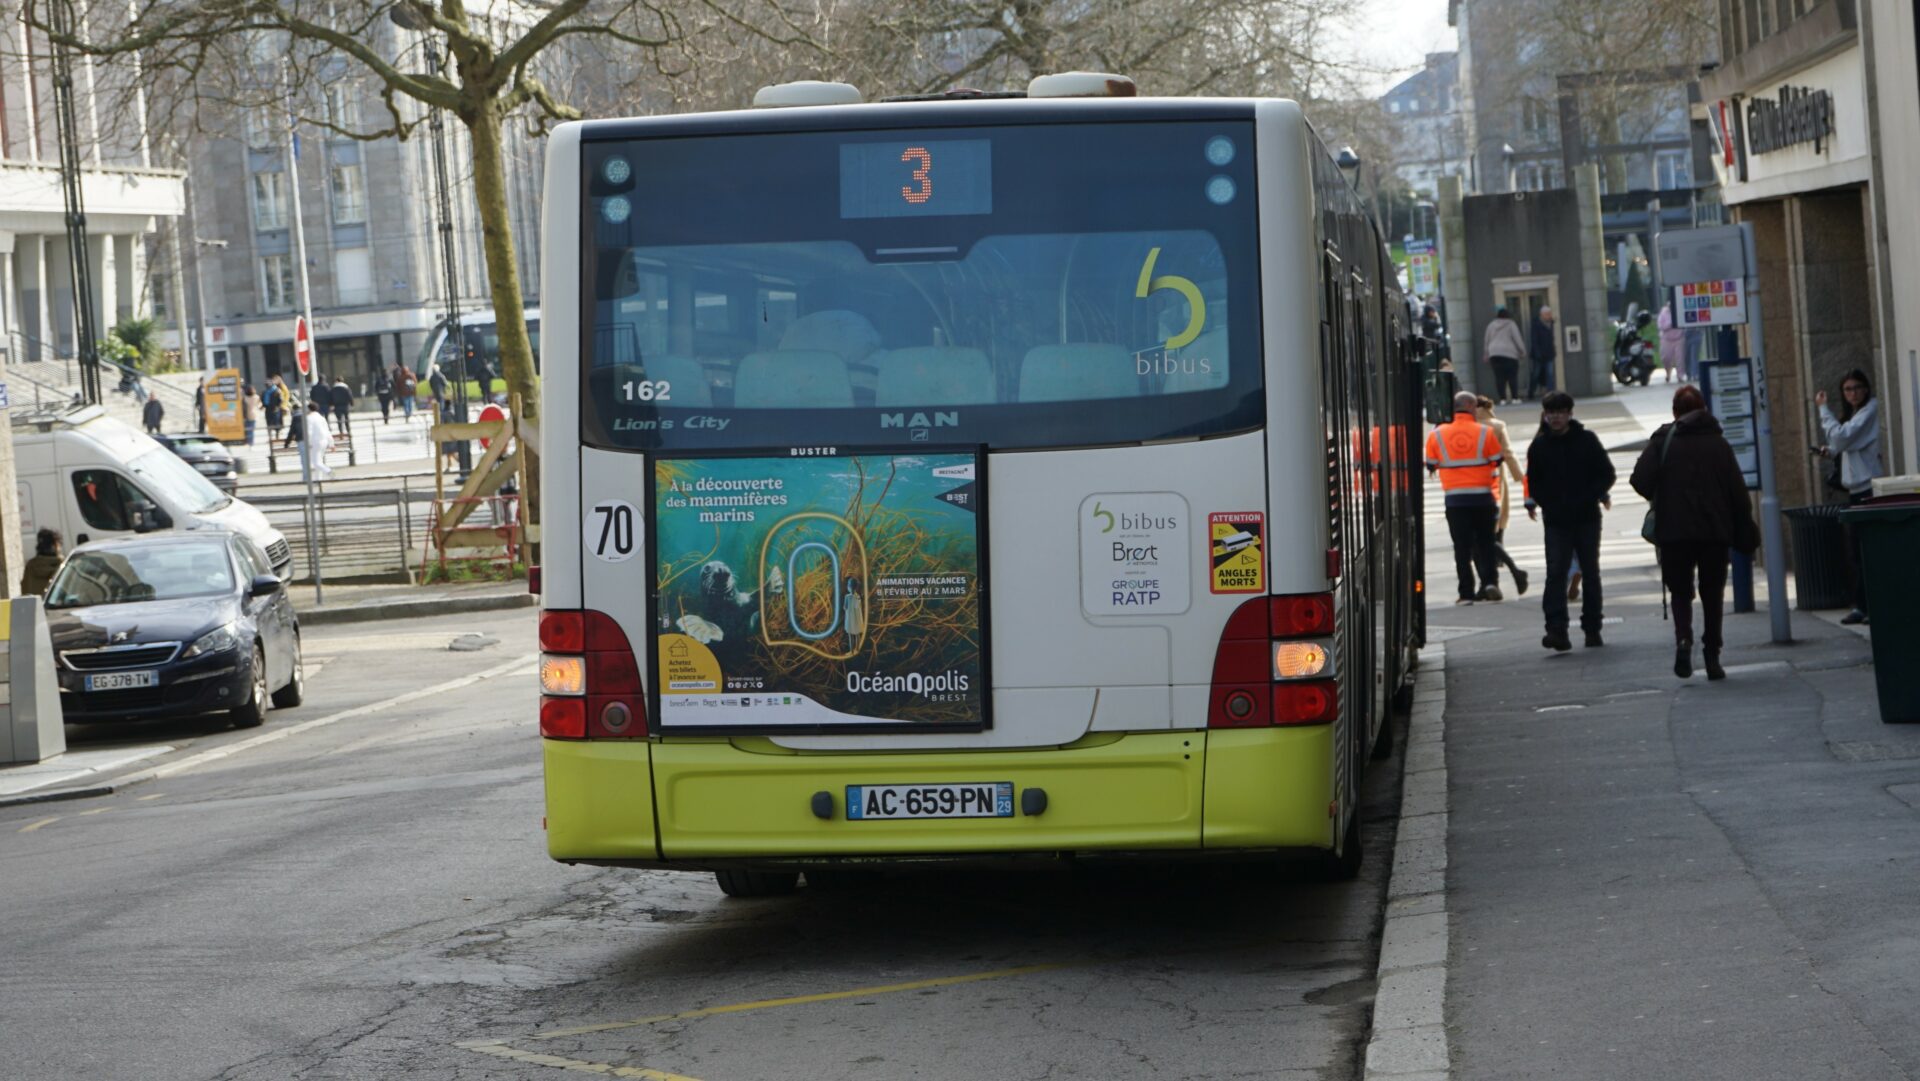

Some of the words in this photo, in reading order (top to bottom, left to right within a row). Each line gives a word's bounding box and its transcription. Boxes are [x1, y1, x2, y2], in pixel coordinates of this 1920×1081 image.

[901, 146, 931, 204] 3
[1136, 351, 1211, 375] bibus
[622, 381, 671, 401] 162
[613, 417, 674, 431] Lion's
[683, 416, 731, 431] City
[880, 411, 959, 428] MAN
[790, 447, 837, 456] BUSTER
[670, 478, 679, 492] À
[682, 480, 693, 491] la
[696, 477, 783, 491] découverte
[666, 497, 687, 507] des
[689, 492, 788, 507] mammifères
[699, 508, 755, 522] marins
[1121, 512, 1177, 530] bibus
[1212, 514, 1261, 522] ATTENTION
[595, 505, 633, 555] 70
[1112, 541, 1158, 561] Brest
[876, 577, 925, 585] ANIMATIONS
[925, 576, 966, 584] VACANCES
[1218, 569, 1257, 578] ANGLES
[1112, 579, 1159, 589] GROUPE
[1220, 578, 1256, 587] MORTS
[884, 587, 919, 596] FÉVRIER
[1112, 591, 1160, 605] RATP
[931, 694, 967, 702] BREST
[852, 806, 858, 814] F
[866, 787, 993, 815] AC-659-PN
[997, 800, 1011, 813] 29
